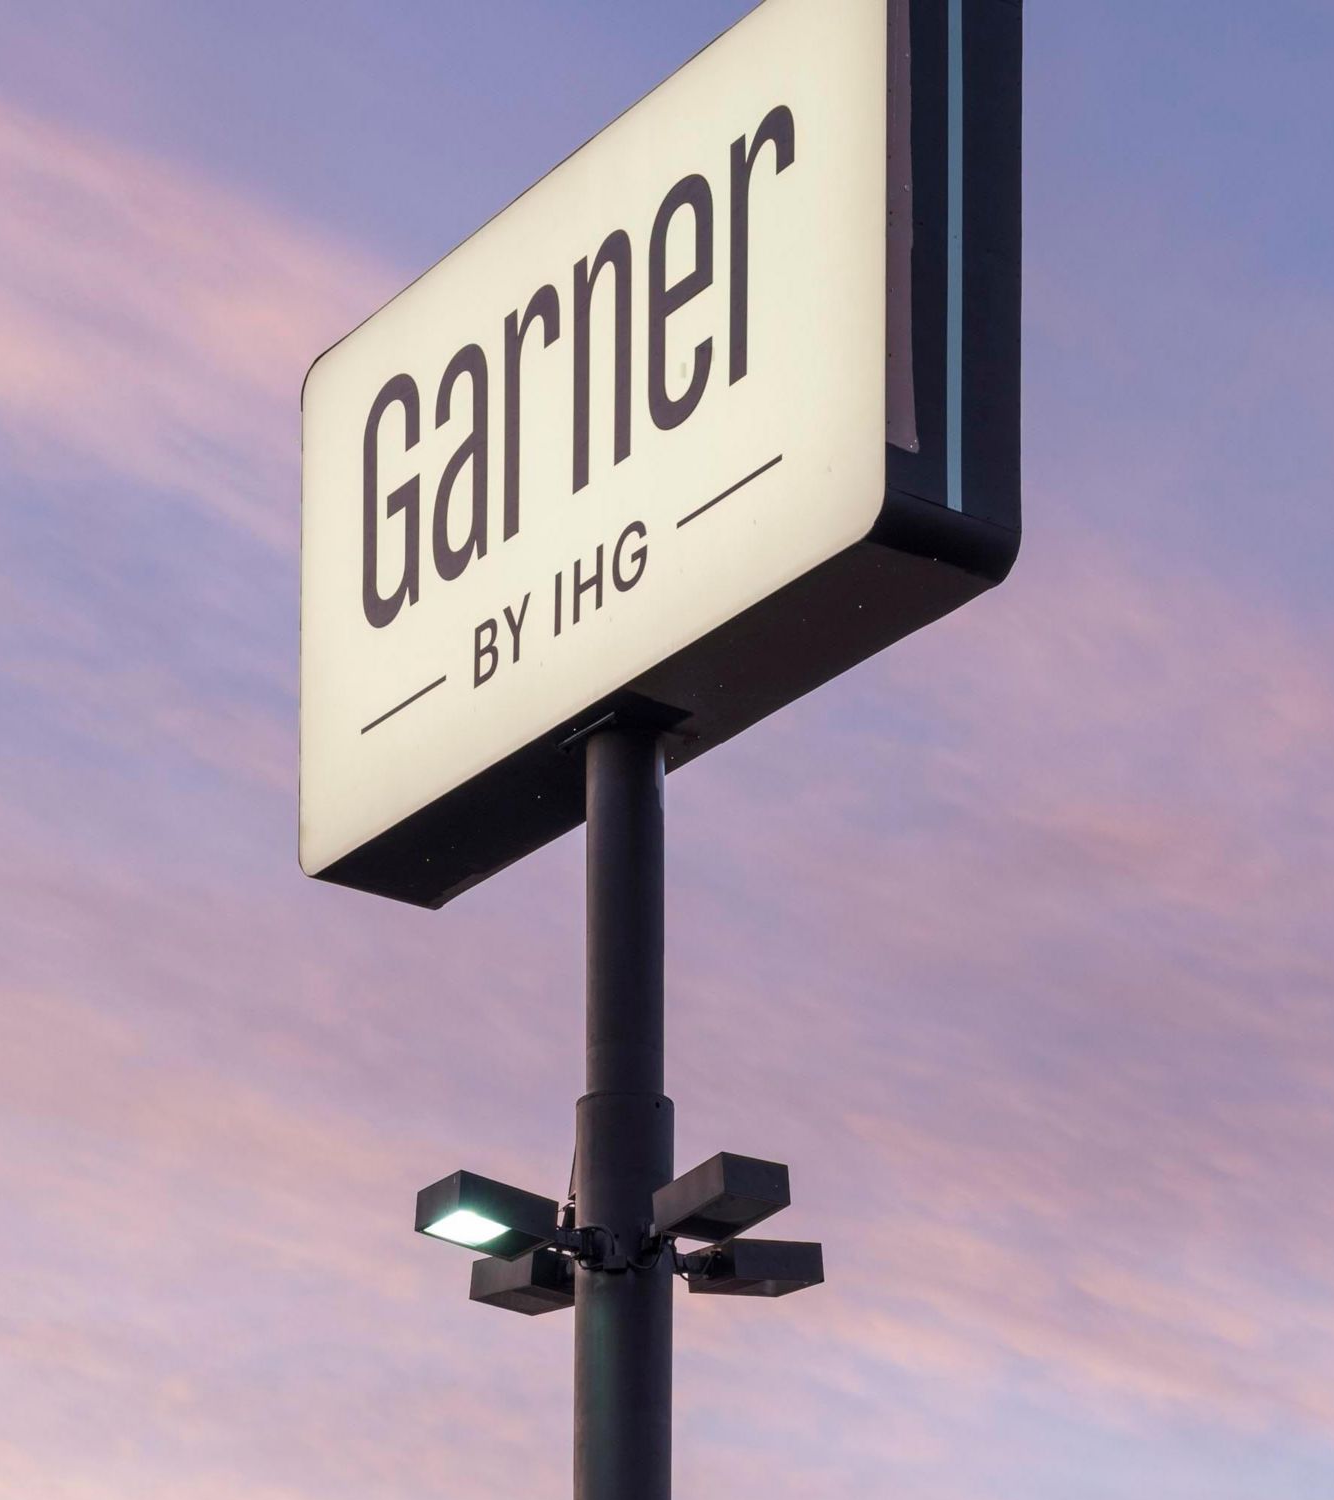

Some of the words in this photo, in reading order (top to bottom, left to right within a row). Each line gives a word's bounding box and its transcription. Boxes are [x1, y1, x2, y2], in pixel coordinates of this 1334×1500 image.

[362, 104, 795, 629] Garner
[473, 592, 532, 689] BY
[553, 520, 649, 637] IHG
